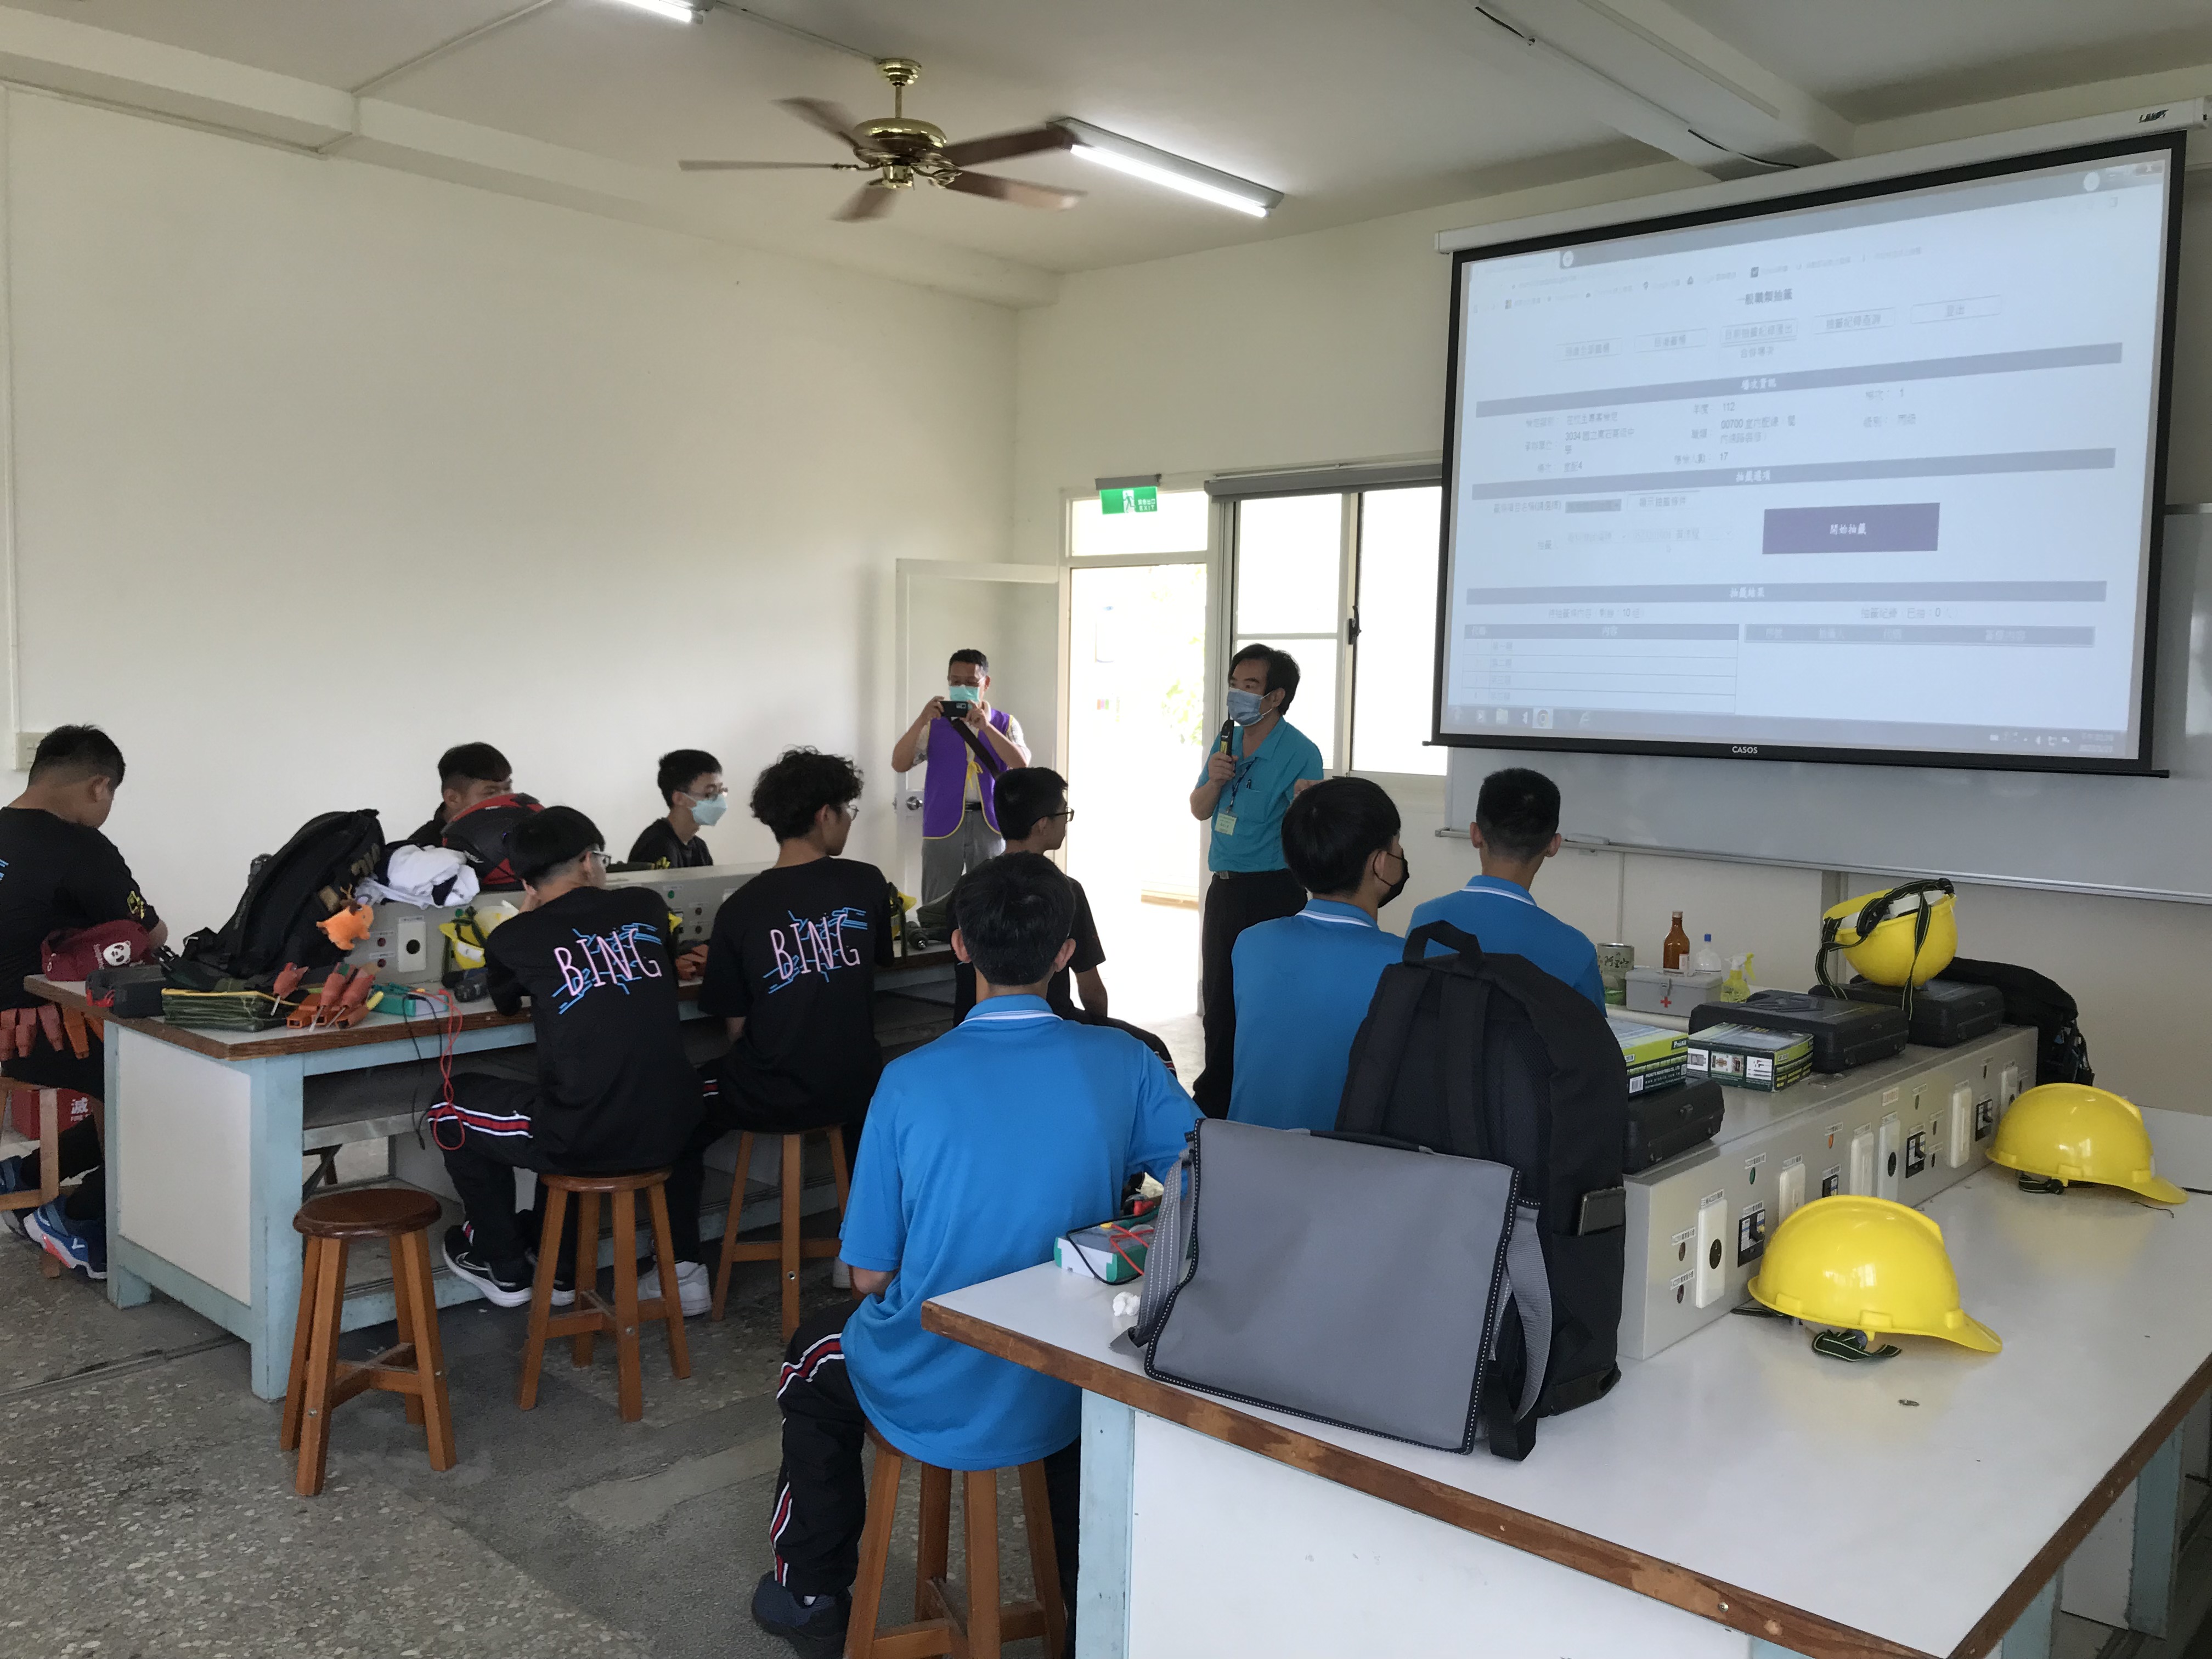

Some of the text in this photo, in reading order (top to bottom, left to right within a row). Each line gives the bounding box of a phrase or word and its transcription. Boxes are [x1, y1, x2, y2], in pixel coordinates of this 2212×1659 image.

[1723, 402, 1736, 411] 112
[1720, 452, 1729, 461] 17
[1732, 746, 1758, 754] CASOS
[770, 914, 861, 980] BING
[554, 928, 662, 996] BING
[1604, 955, 1629, 968] 阿里山
